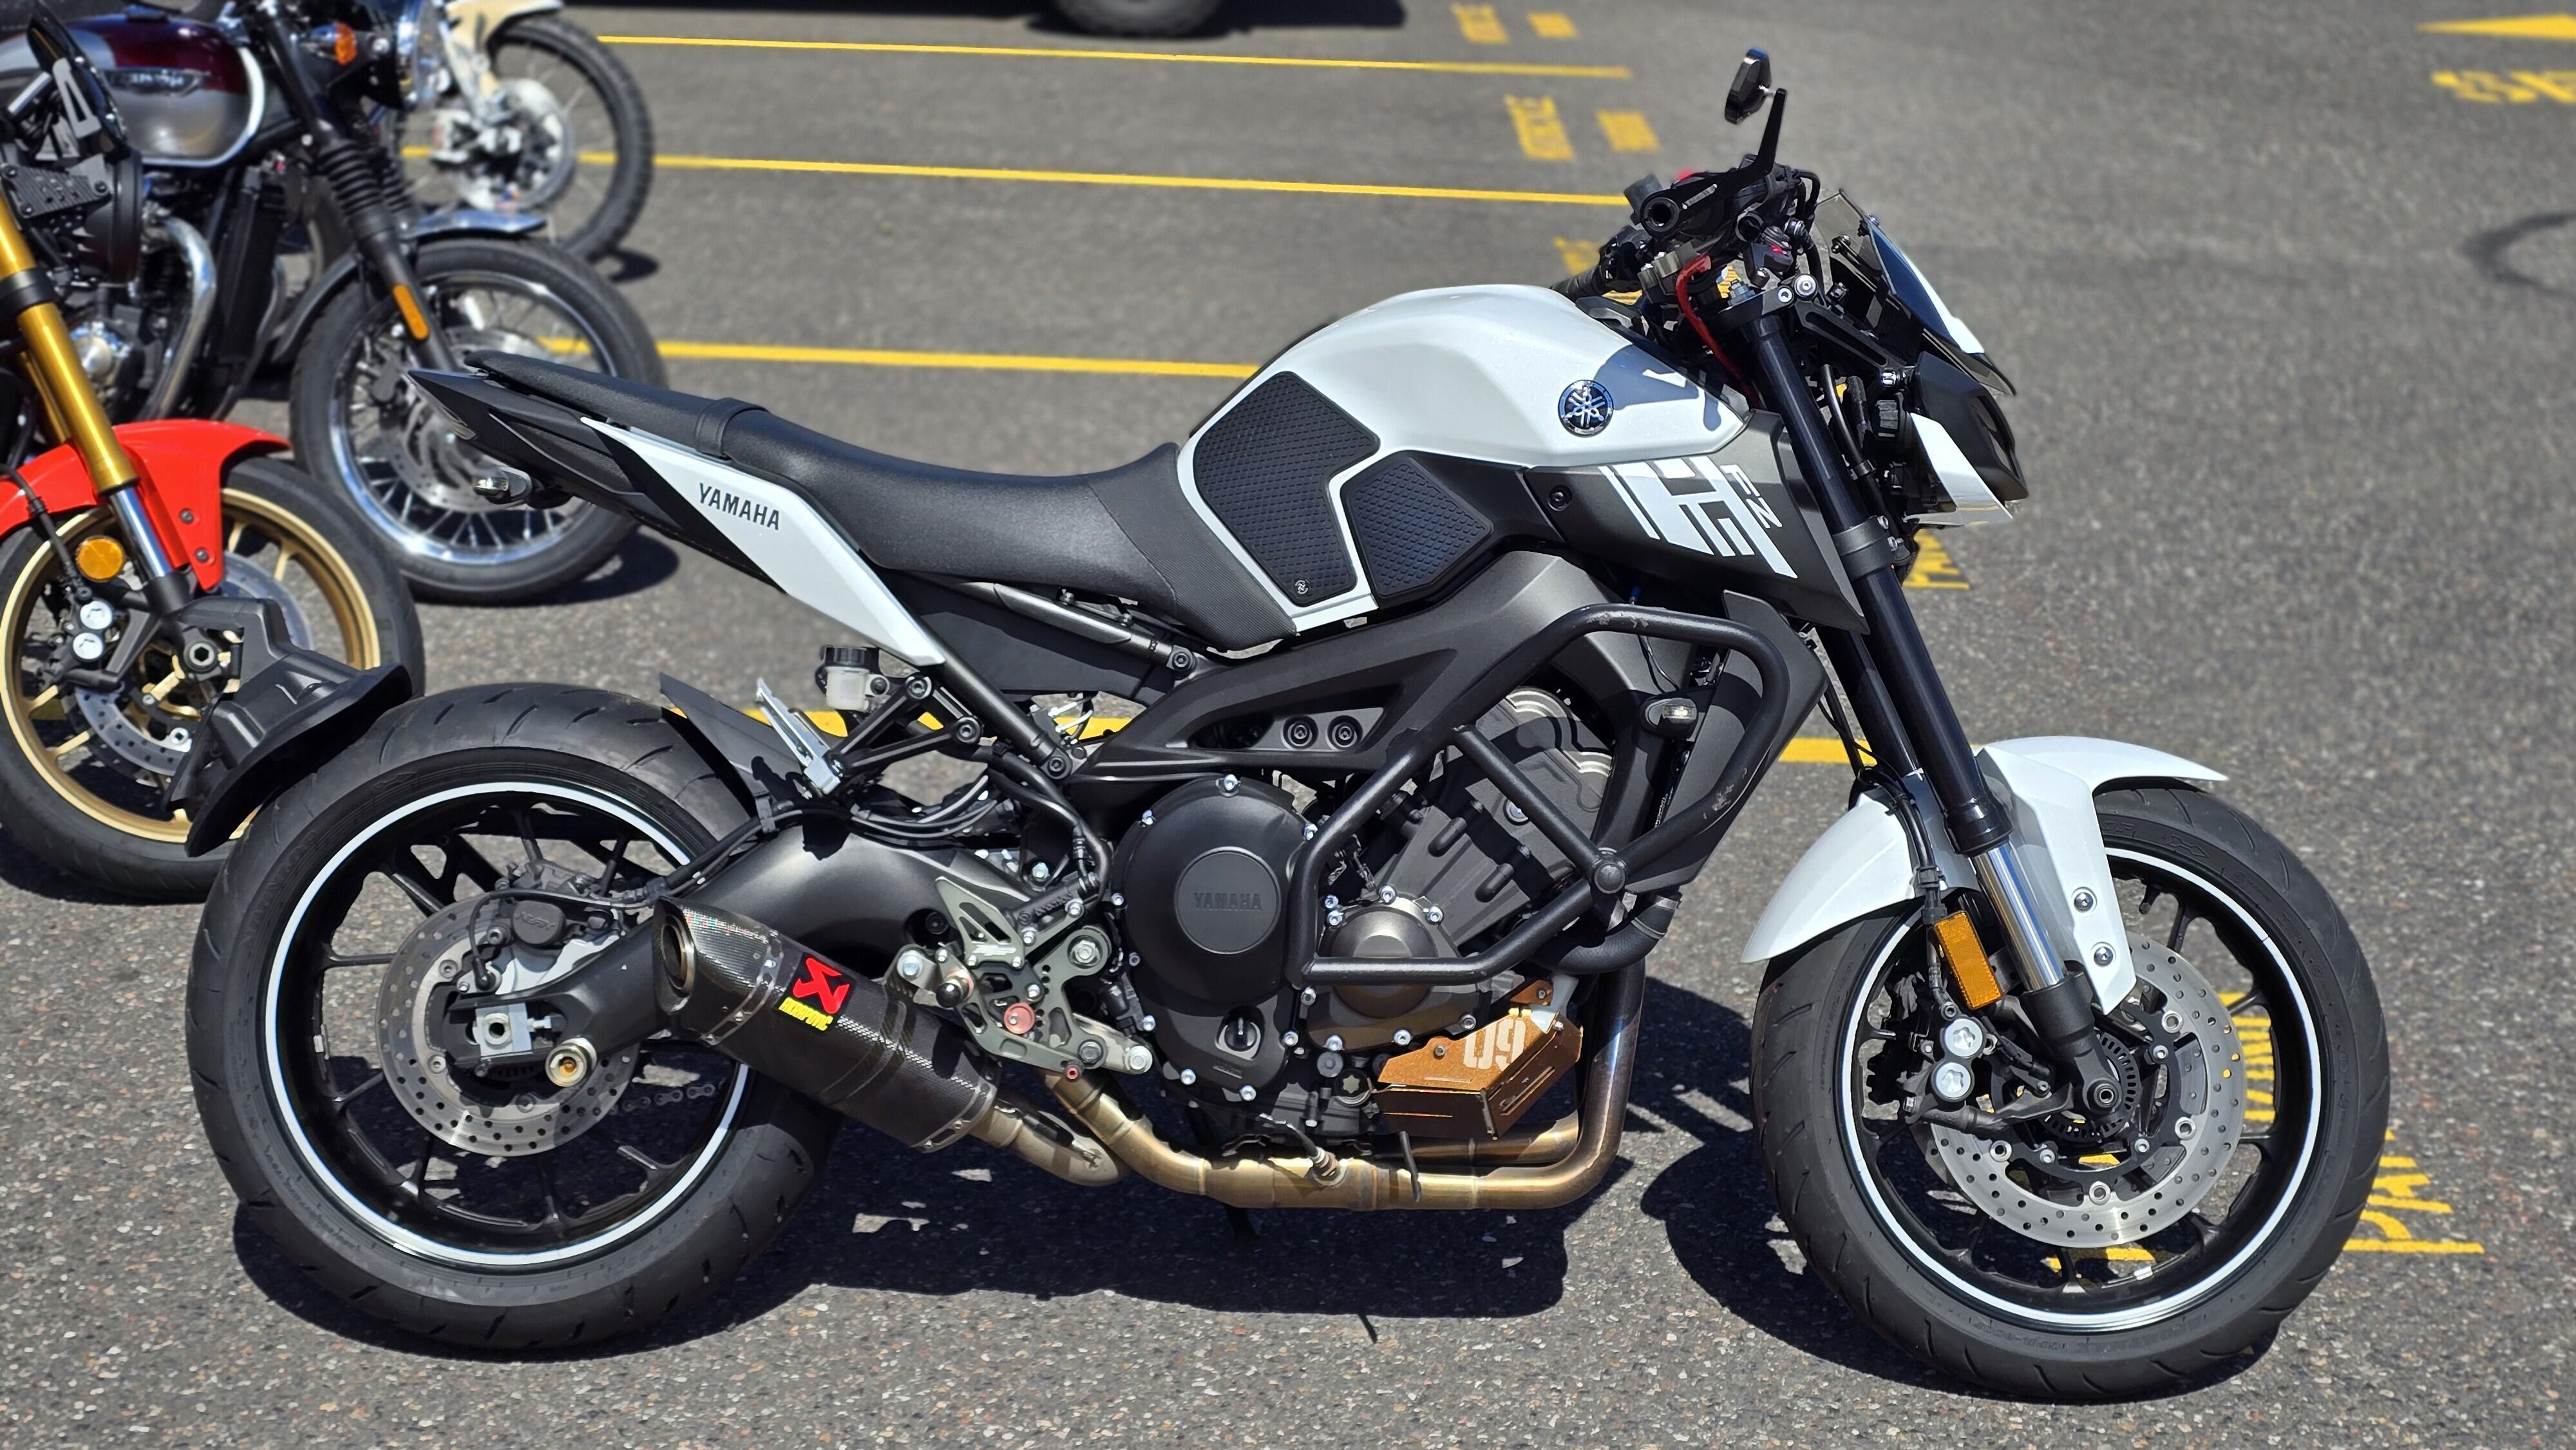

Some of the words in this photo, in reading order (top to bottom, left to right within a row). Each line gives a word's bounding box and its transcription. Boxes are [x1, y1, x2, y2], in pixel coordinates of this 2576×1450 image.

[699, 483, 781, 531] YAMAHA
[1193, 892, 1262, 912] YAMAHA
[1463, 1019, 1527, 1071] 09
